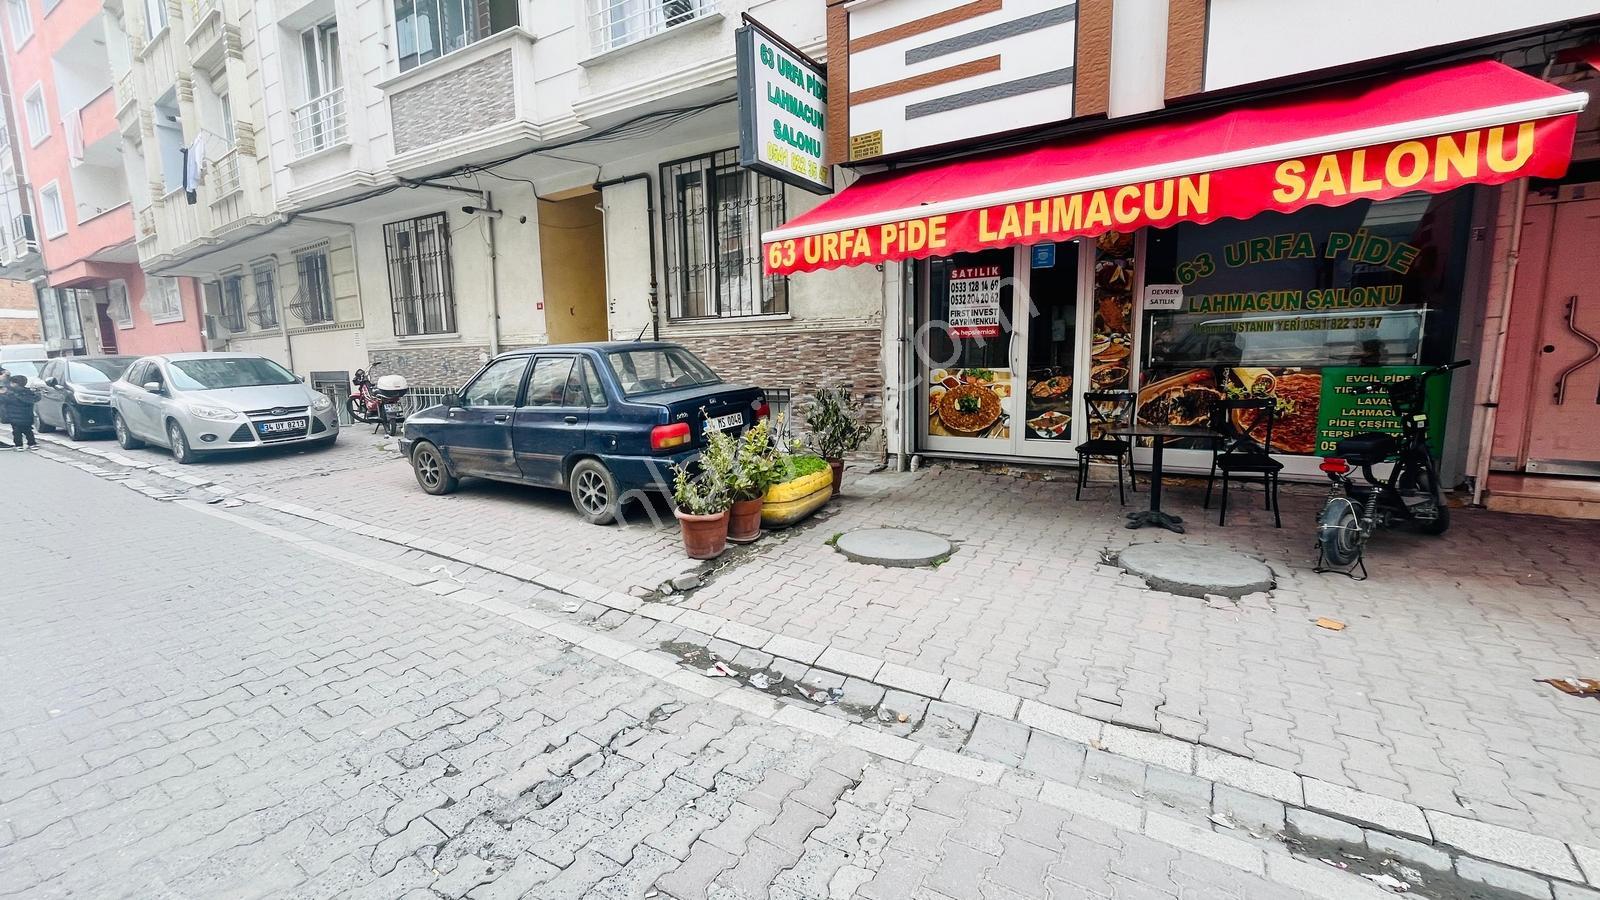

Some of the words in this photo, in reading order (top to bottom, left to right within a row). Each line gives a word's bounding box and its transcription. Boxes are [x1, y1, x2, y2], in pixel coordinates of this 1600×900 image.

[760, 43, 775, 69] 63
[777, 53, 805, 90] URFA
[767, 81, 824, 132] LAHMACUN
[773, 118, 821, 159] SALONU
[1272, 120, 1536, 204] SALONU
[768, 241, 796, 270] 63
[803, 228, 872, 265] URFA
[978, 174, 1211, 243] LAHMACUN
[1176, 252, 1216, 286] 63
[1223, 232, 1317, 269] URFA
[1324, 228, 1421, 275] PİDE
[951, 266, 999, 279] SATILIK
[950, 281, 967, 293] 0533
[968, 280, 980, 292] 128
[981, 280, 989, 291] 14
[990, 279, 999, 291] 69
[950, 293, 967, 305] 0532
[967, 292, 980, 304] 204
[980, 292, 989, 304] 20
[990, 291, 999, 303] 62
[1187, 288, 1302, 314] LAHMACUN
[1306, 284, 1404, 310] SALONU
[950, 309, 970, 318] FIRST
[970, 308, 998, 317] INVEST
[1231, 319, 1274, 333] USTANIN
[1330, 317, 1350, 330] 822
[1352, 317, 1366, 330] 35
[1368, 316, 1383, 329] 47
[1345, 374, 1381, 384] EVCİL
[287, 420, 305, 429] 8213
[1328, 418, 1355, 427] PİDE
[1321, 429, 1355, 438] TEPSİ
